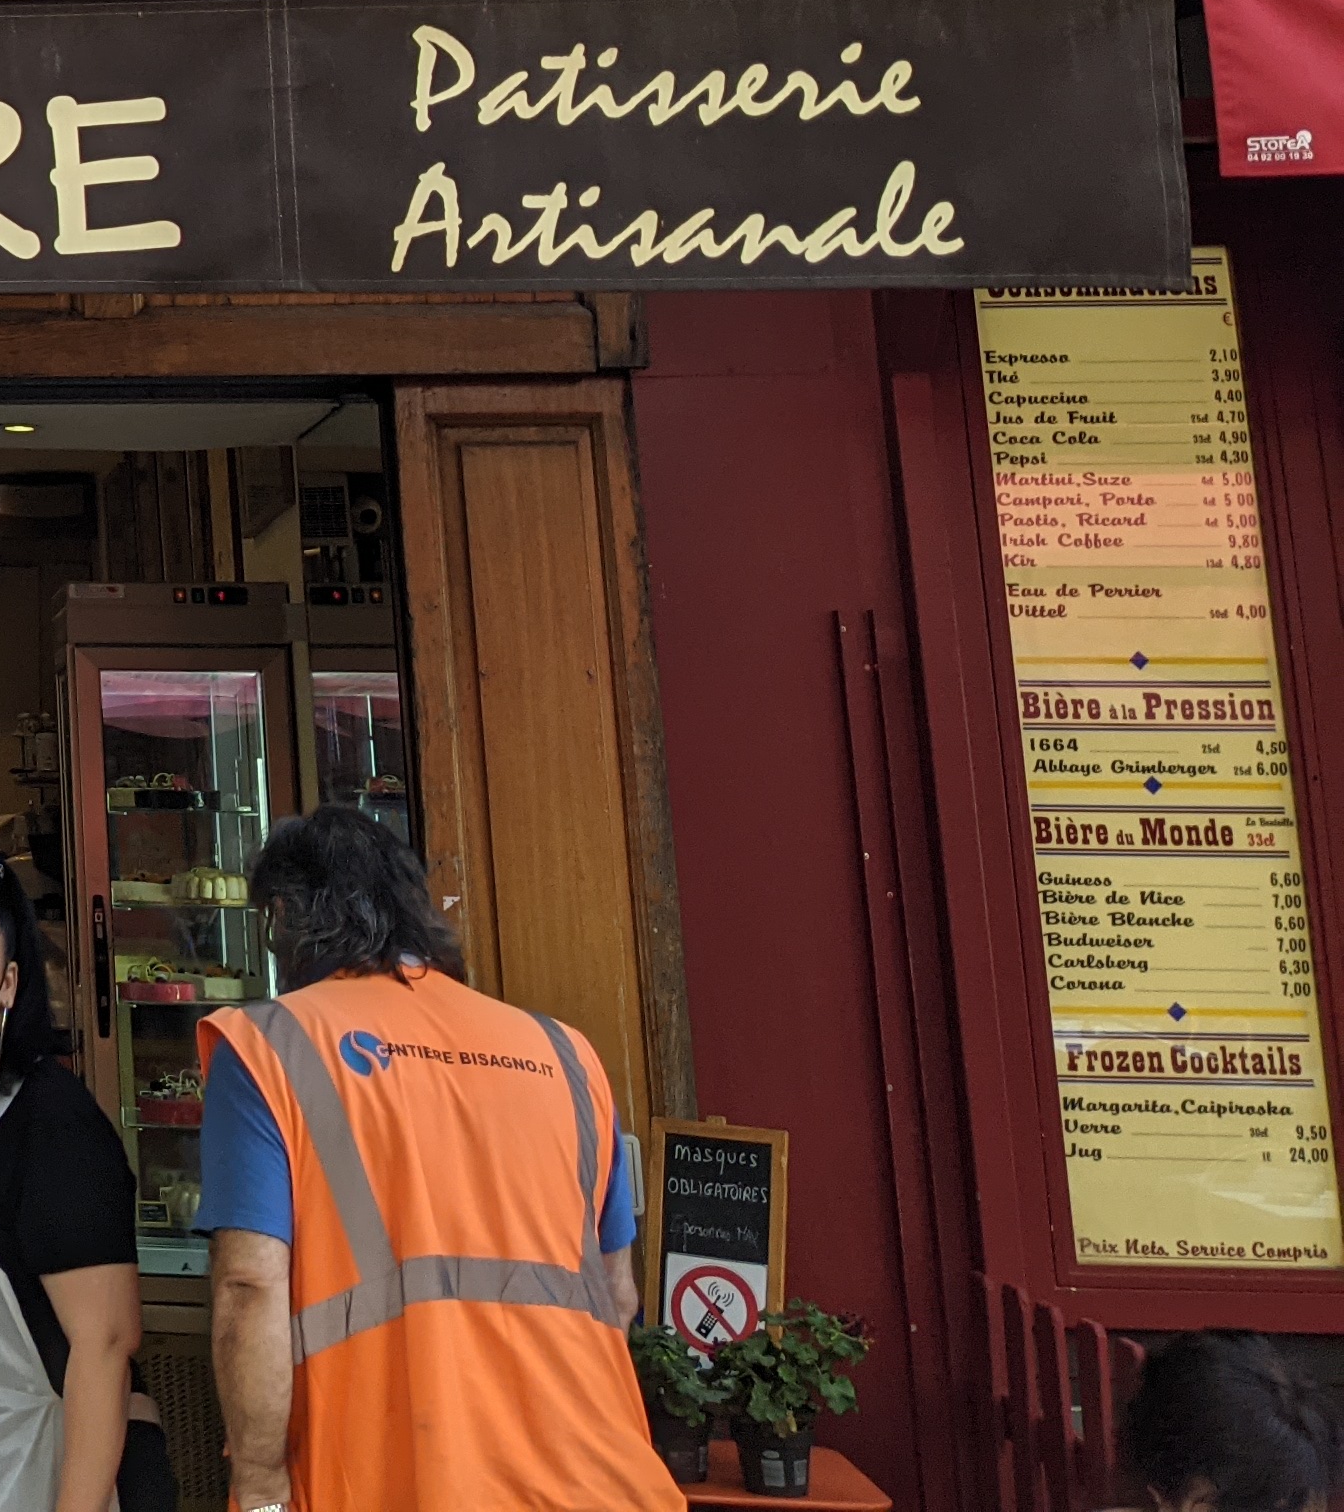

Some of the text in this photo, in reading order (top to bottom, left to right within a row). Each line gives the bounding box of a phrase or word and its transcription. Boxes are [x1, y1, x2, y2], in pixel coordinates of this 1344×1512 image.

[409, 23, 922, 132] Patisserie
[390, 160, 966, 275] Artisanale
[1223, 311, 1233, 326] €
[983, 350, 1070, 367] Expresso
[985, 370, 1020, 384] Thé
[988, 391, 1090, 408] Capuccino
[989, 411, 1024, 425] Jus
[1034, 411, 1058, 424] de
[1067, 410, 1118, 425] Fruit
[992, 431, 1043, 445] Coca
[1052, 431, 1102, 445] Cola
[994, 451, 1048, 468] Pepsi
[1099, 492, 1157, 506] Porto
[1075, 513, 1148, 527] Ricard
[1001, 533, 1048, 547] Irish
[1057, 533, 1125, 549] Coffee
[1004, 553, 1038, 568] Kir
[1006, 583, 1163, 598] Eau de Perrier
[1009, 603, 1068, 618] Vittel
[1020, 691, 1276, 722] Bière à la Pression
[1029, 737, 1080, 753] 1664
[1033, 759, 1103, 776] Abbaye
[1110, 759, 1218, 778] Grimberger
[1033, 816, 1109, 846] Bière
[1116, 829, 1134, 846] du
[1139, 817, 1234, 847] Monde
[1247, 832, 1276, 847] 33cl
[1038, 871, 1112, 887] Guiness
[1039, 890, 1097, 906] Bière
[1105, 891, 1131, 906] de
[1139, 890, 1186, 906] Nice
[1041, 911, 1100, 927] Bière
[1107, 912, 1195, 928] Blanche
[1043, 932, 1155, 949] Budweiser
[1047, 953, 1150, 973] Carlsberg
[1050, 975, 1125, 991] Corona
[459, 1051, 554, 1078] BISAGNO.IT
[1065, 1042, 1302, 1076] Frozen Cocktails
[1064, 1119, 1122, 1135] Verre
[1064, 1143, 1103, 1161] Jug
[667, 1177, 770, 1204] OBLIGATOIRES
[1077, 1237, 1119, 1255] Prix
[1176, 1240, 1246, 1258] Service
[1252, 1241, 1329, 1262] Compris
